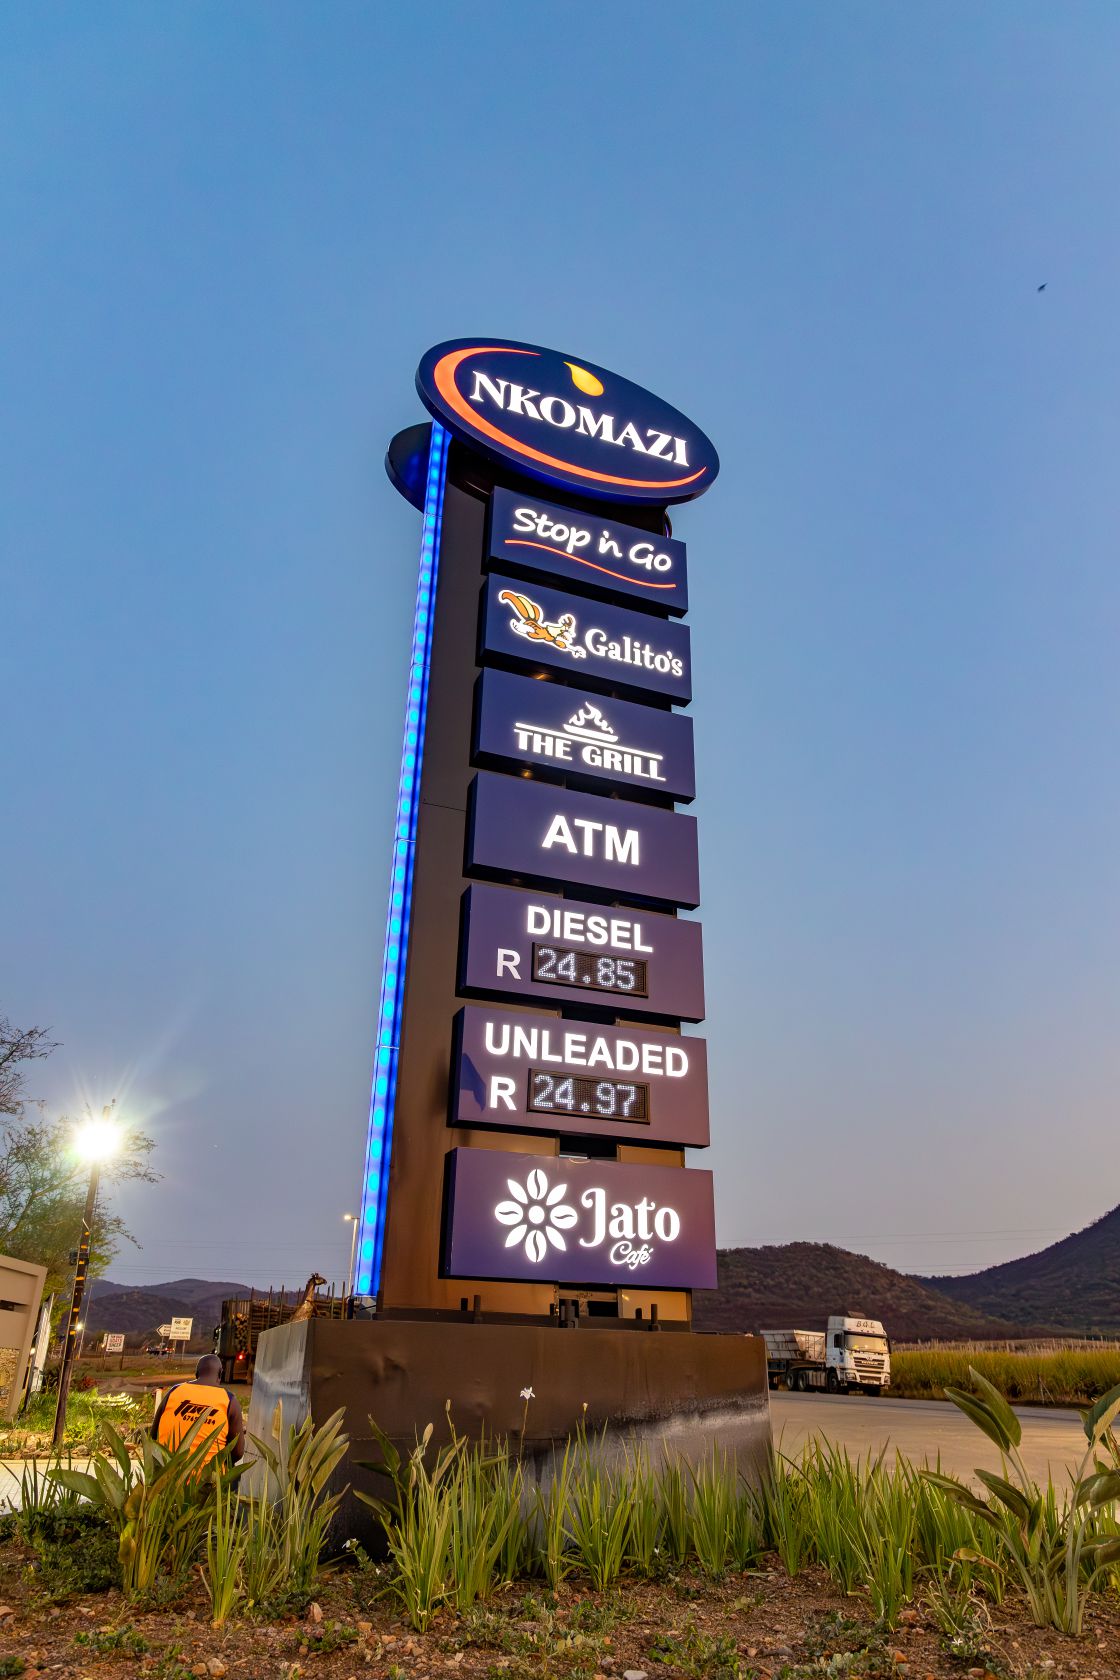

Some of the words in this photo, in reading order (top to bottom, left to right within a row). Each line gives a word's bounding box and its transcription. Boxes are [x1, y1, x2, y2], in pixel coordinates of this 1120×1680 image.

[469, 371, 690, 467] NKOMAZI
[513, 508, 591, 554] Stop
[629, 543, 672, 571] Go
[585, 628, 683, 676] Galito's
[514, 728, 572, 761] THE
[581, 745, 667, 781] GRILL
[541, 814, 640, 866] ATM
[526, 905, 653, 953] DIESEL
[496, 948, 522, 980] R
[537, 948, 635, 990] 24.85
[484, 1022, 689, 1078] UNLEADED
[489, 1076, 517, 1111] R
[533, 1074, 635, 1117] 24.97
[578, 1187, 681, 1248] Jato
[609, 1240, 654, 1270] Café
